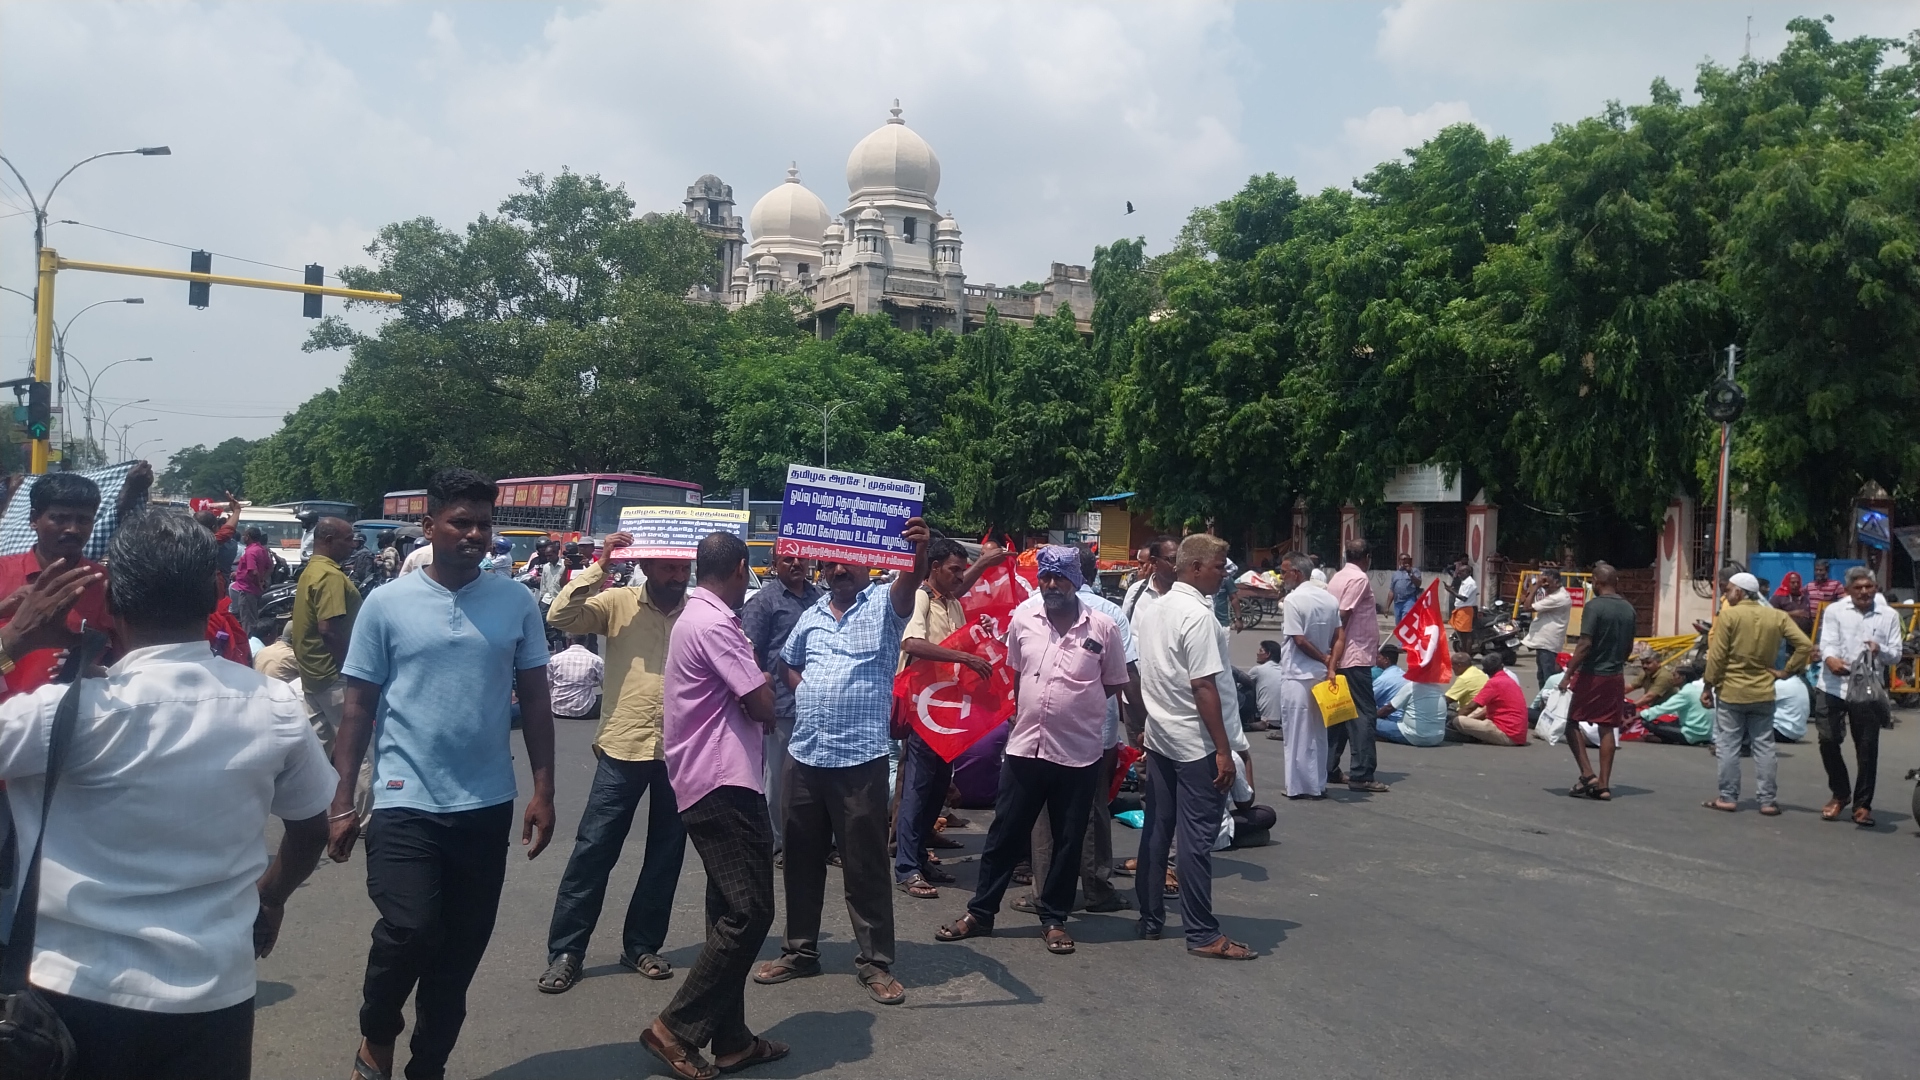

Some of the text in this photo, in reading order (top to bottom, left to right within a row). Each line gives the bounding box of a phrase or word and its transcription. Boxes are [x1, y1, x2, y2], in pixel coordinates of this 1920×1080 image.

[790, 468, 826, 483] தமிழக
[828, 474, 861, 486] அரசே
[868, 480, 916, 496] முதல்வரே
[410, 500, 423, 511] GOLD
[516, 489, 528, 502] GOLD
[689, 493, 700, 501] MTC
[790, 487, 912, 519] ஓய்வு பெற்ற தொழிலாளர்களுக்கு
[815, 509, 887, 531] கொடுக்க வேண்டிய
[783, 523, 795, 536] ரூ.
[796, 522, 816, 536] 2000
[817, 524, 854, 543] கோடியை
[855, 529, 881, 544] உடனே
